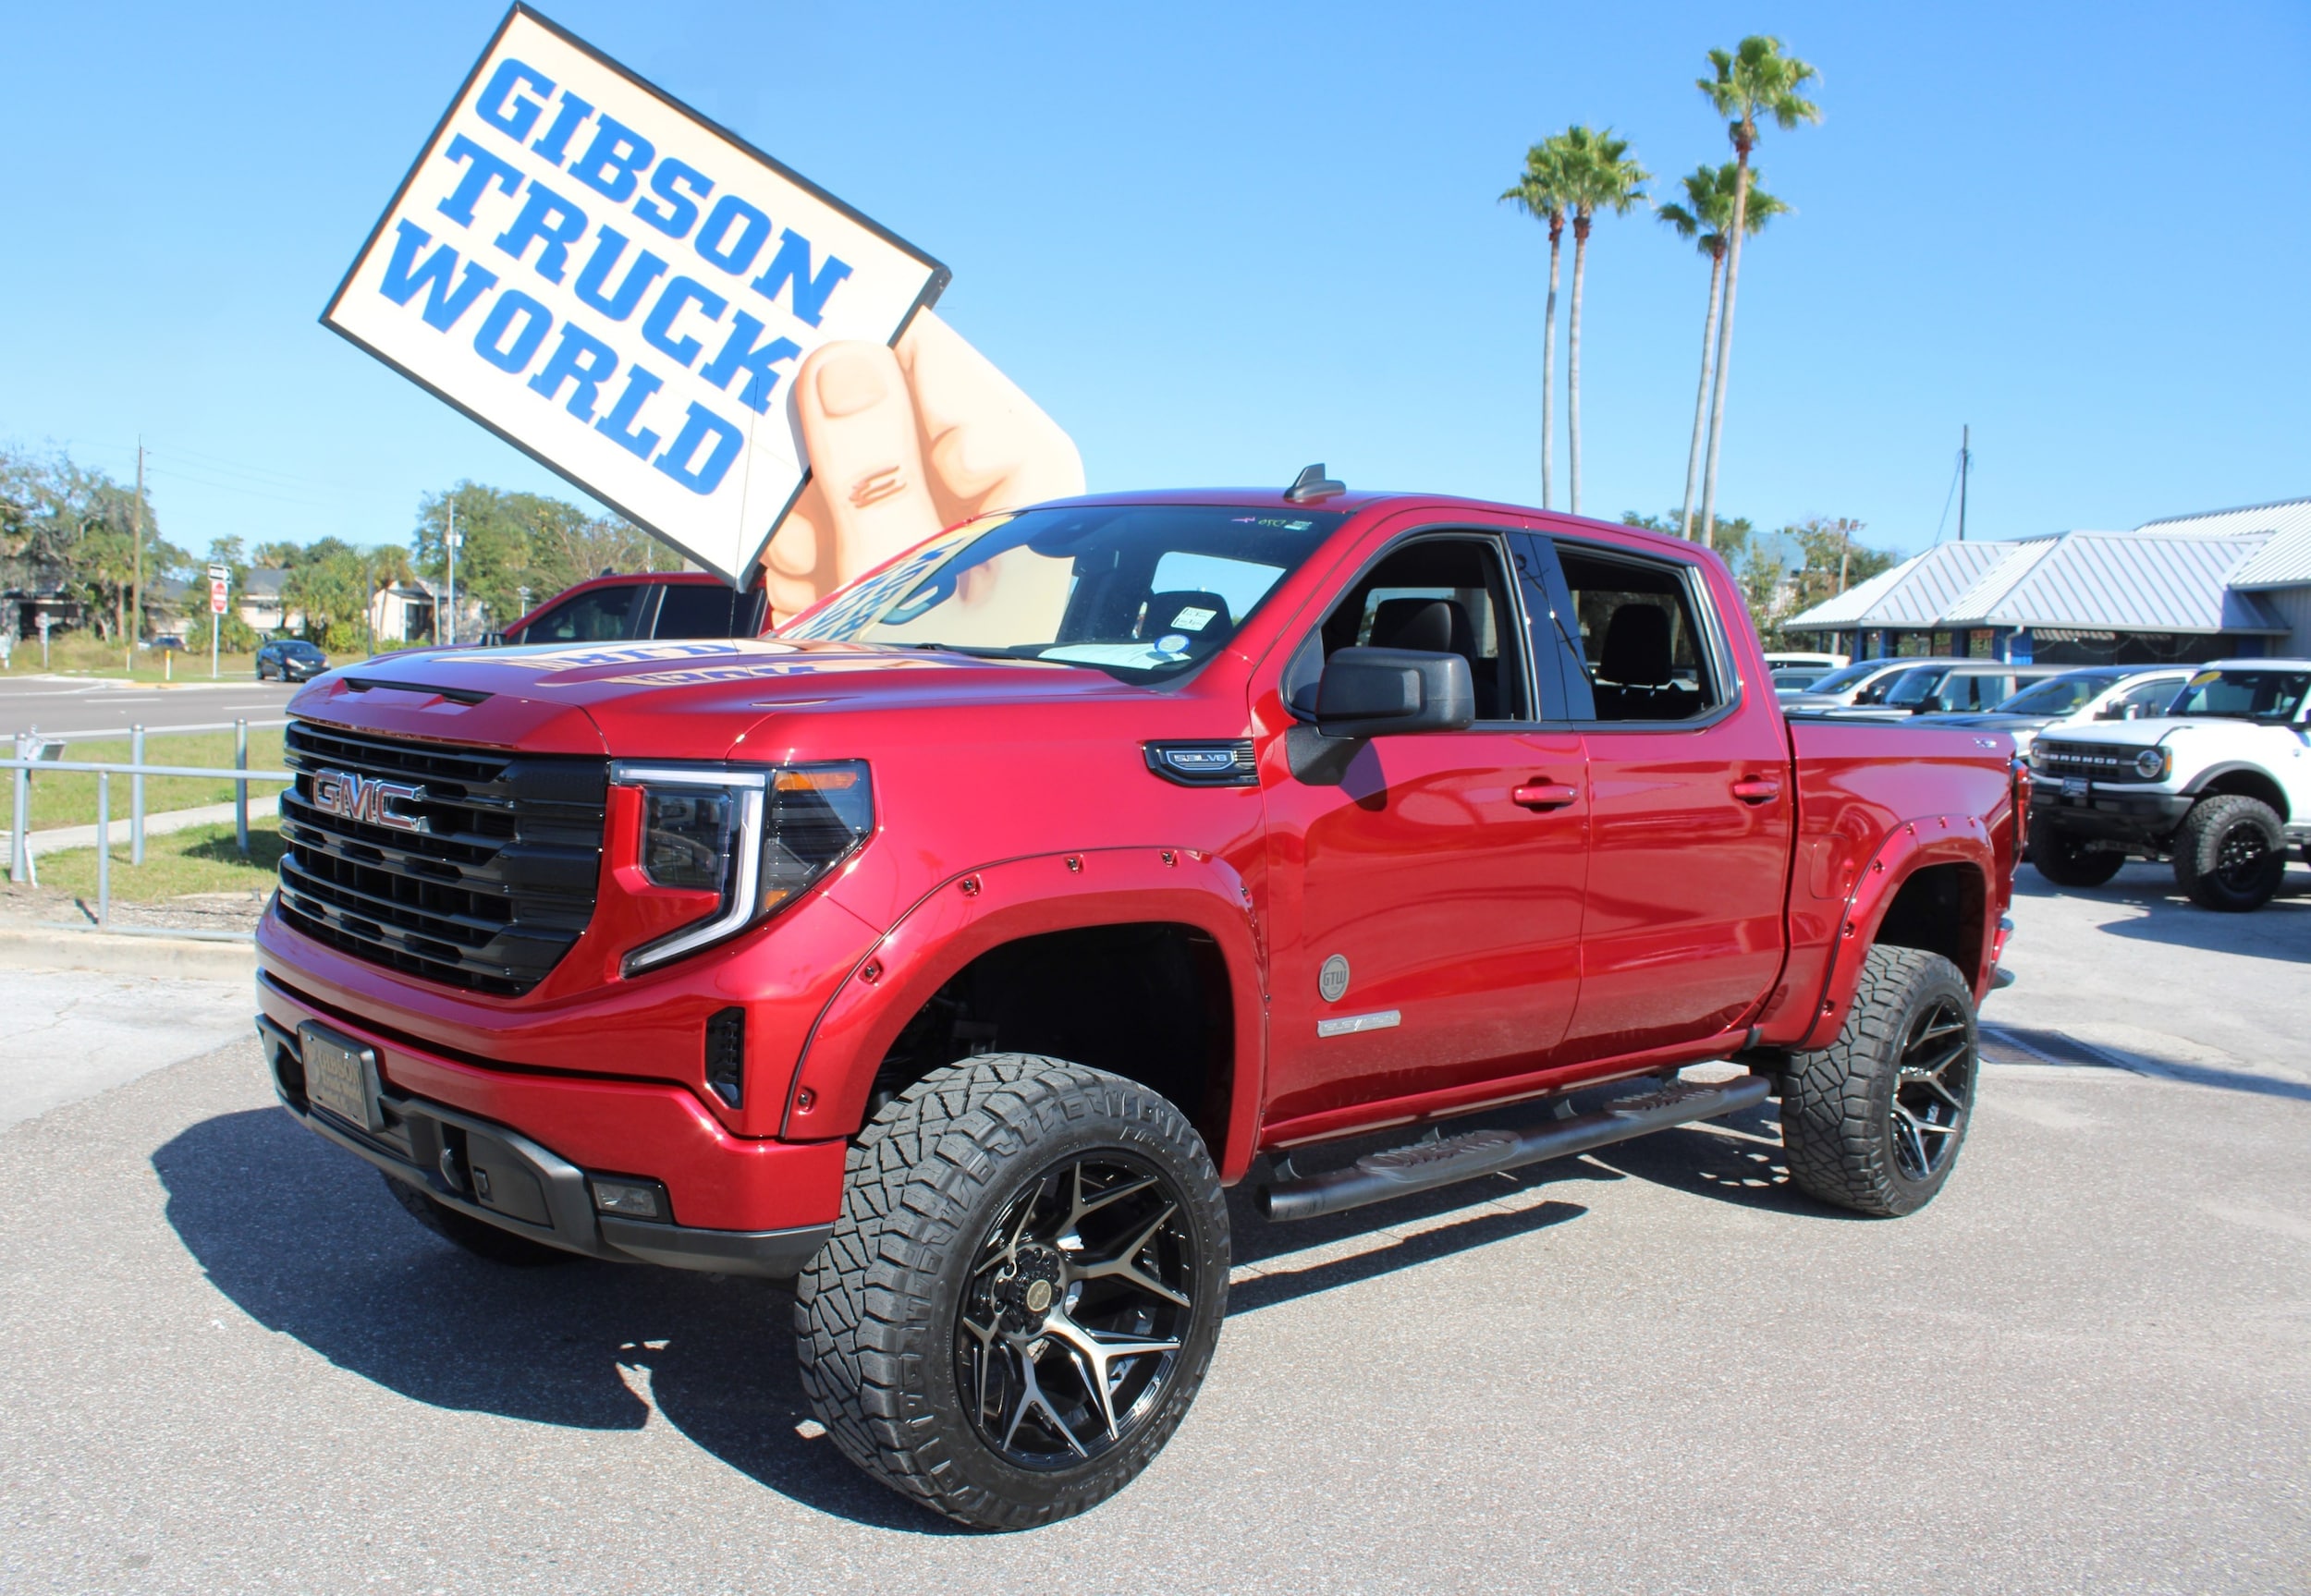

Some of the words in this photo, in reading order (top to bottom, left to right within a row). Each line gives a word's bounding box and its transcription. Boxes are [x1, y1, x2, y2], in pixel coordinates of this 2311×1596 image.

[436, 132, 802, 416] TRUCK
[474, 57, 852, 329] GIBSON
[379, 217, 745, 496] WORLD
[312, 767, 431, 833] GMC
[2049, 754, 2117, 765] BRONCO
[1323, 969, 1347, 986] GTW
